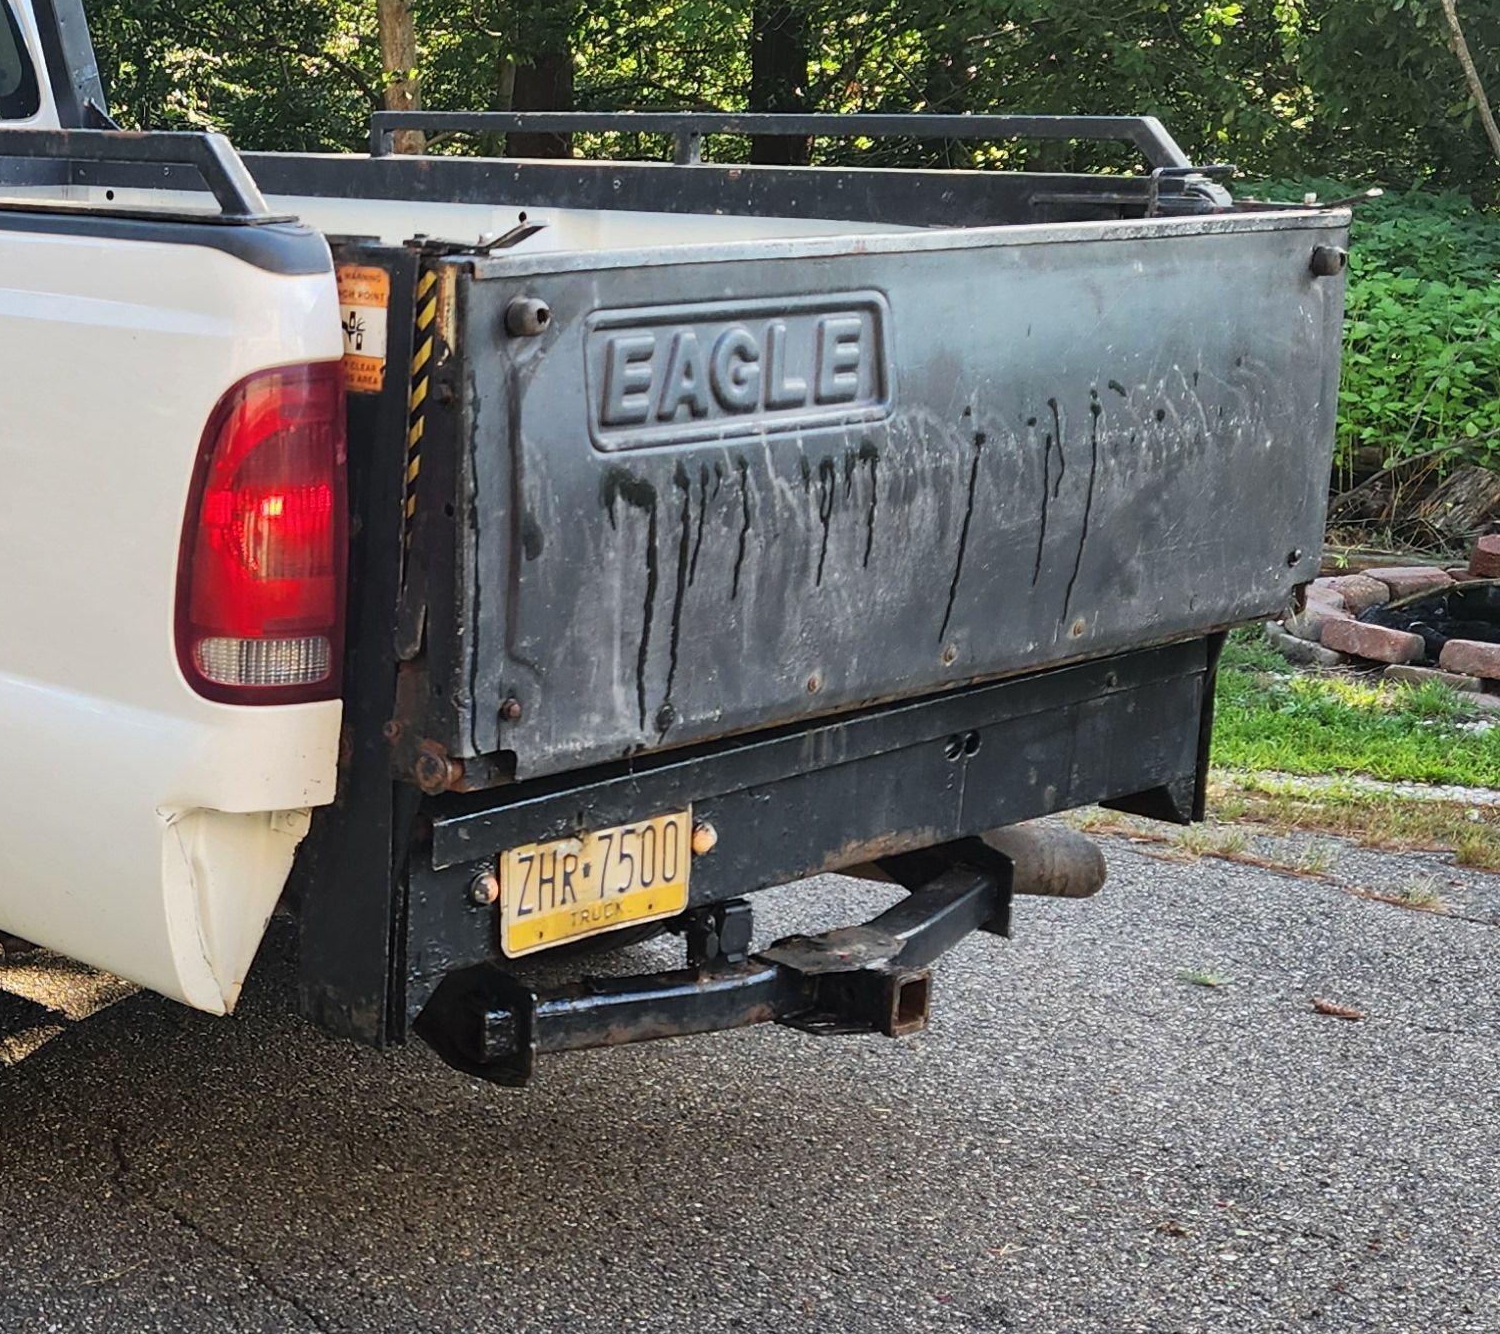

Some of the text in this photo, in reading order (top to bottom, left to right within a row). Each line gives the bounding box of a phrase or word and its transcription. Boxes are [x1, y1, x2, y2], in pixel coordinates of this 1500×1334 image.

[350, 361, 376, 371] CLEAR
[600, 317, 862, 427] EAGLE
[357, 374, 378, 385] AREA
[569, 899, 624, 928] TRUCK
